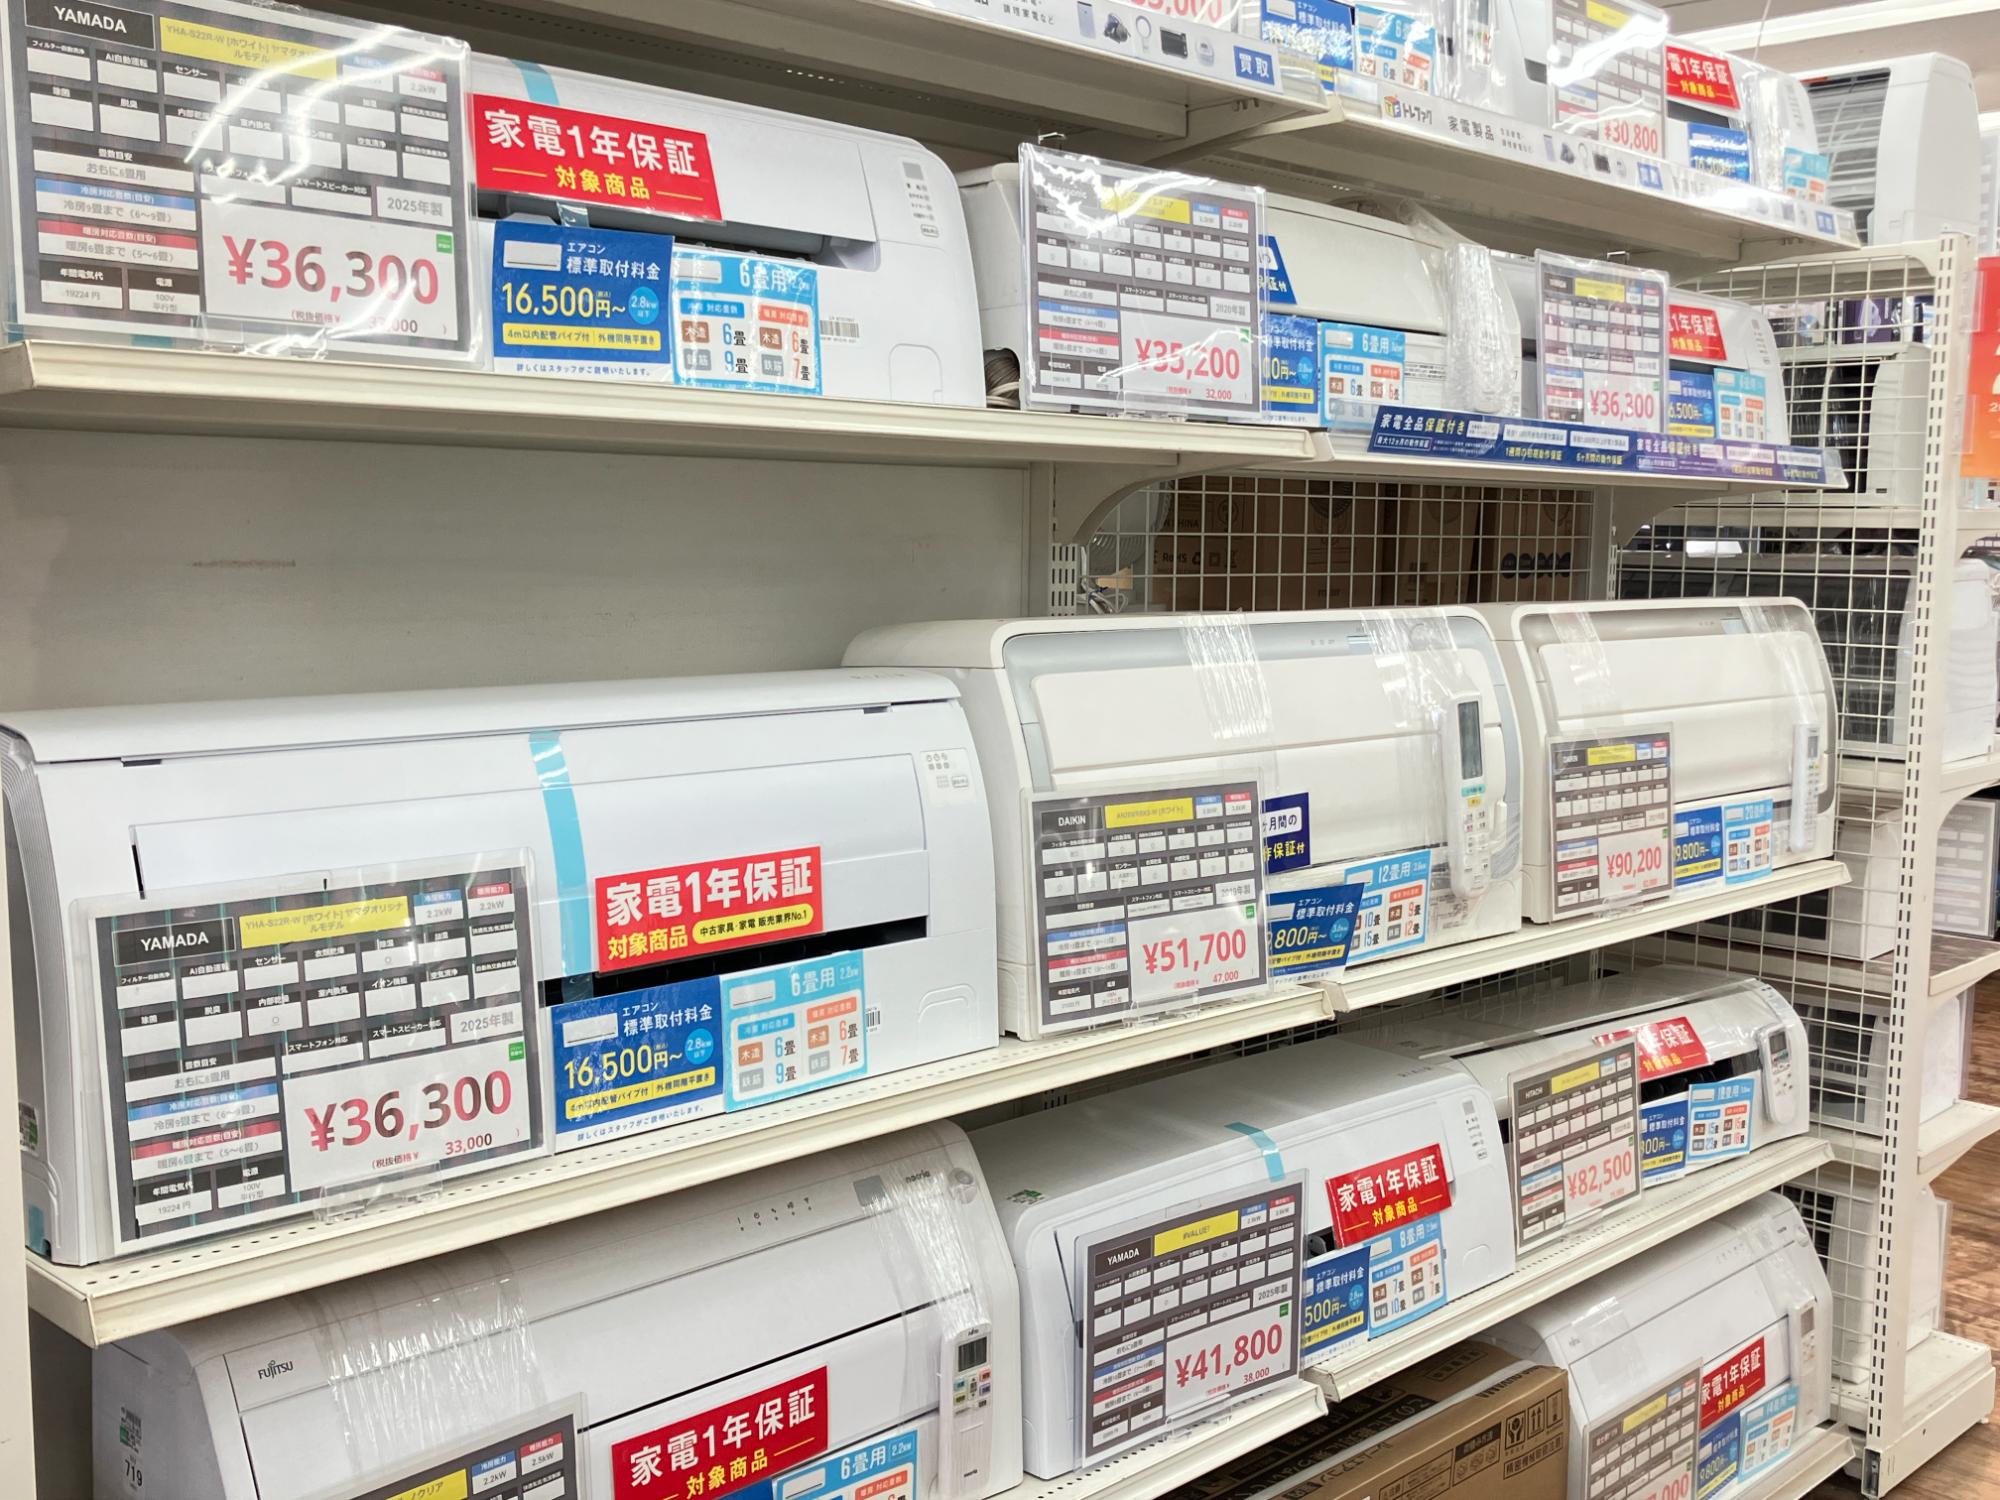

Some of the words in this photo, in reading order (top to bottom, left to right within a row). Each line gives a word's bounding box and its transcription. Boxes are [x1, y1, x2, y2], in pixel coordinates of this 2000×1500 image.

[54, 5, 127, 34] YAMADA
[1238, 51, 1275, 80] 買取
[1666, 53, 1729, 84] 電1年保証
[1448, 116, 1495, 142] 家電製品
[1604, 120, 1658, 154] ¥30,800
[483, 108, 700, 179] 家電1年保証
[554, 165, 651, 200] 対象商品
[387, 198, 443, 216] 2025年製
[567, 242, 606, 255] エアコン
[222, 234, 439, 305] ¥36,300
[566, 256, 661, 282] 標準取付料金
[739, 262, 789, 291] 6畳用
[91, 292, 100, 301] 円
[722, 322, 745, 347] 6畳
[791, 330, 809, 355] 6畳
[1362, 333, 1390, 354] 6畳用
[723, 351, 749, 374] 9畳
[1136, 337, 1240, 380] ¥35,200
[1206, 390, 1232, 400] 32,000
[1590, 389, 1654, 421] ¥36,300
[1380, 413, 1465, 436] 家電全品保証付き
[1058, 815, 1086, 826] DAIKIN
[1378, 862, 1410, 883] 12畳用
[1606, 847, 1661, 878] ¥90,200
[605, 855, 813, 927] 家電1年保証
[426, 906, 452, 919] 2.2kW
[479, 901, 505, 911] 2.2kW
[1296, 903, 1355, 921] 標準取付料金
[310, 921, 345, 933] ルモデル
[758, 909, 808, 928] 販売業界No.1
[141, 932, 209, 952] YAMADA
[607, 924, 688, 961] 対象商品
[1143, 928, 1246, 975] ¥51,700
[255, 955, 286, 966] センサー
[791, 966, 835, 996] 6畳用
[1213, 970, 1239, 983] 47,000
[622, 1002, 659, 1016] エアコン
[623, 1004, 713, 1037] 標準取付料金
[372, 1019, 442, 1039] スマートスピーカー対応
[460, 1011, 515, 1033] 2025年製
[810, 1031, 827, 1043] 木造
[839, 1020, 858, 1040] 6畳
[288, 1035, 349, 1053] スマートフォン対応
[742, 1047, 761, 1061] 木造
[775, 1036, 796, 1058] 6畳
[840, 1044, 859, 1065] 7畳
[775, 1063, 796, 1084] 9畳
[304, 1070, 512, 1152] ¥36,300
[445, 1132, 492, 1155] 33,000
[1337, 1154, 1440, 1214] 家電1年保証
[1567, 1150, 1632, 1200] ¥82,500
[182, 1201, 191, 1210] 円
[1372, 1196, 1418, 1228] 対象商品
[1399, 1224, 1425, 1248] 8畳用
[1107, 1247, 1140, 1266] YAMADA
[1316, 1268, 1336, 1280] エアコン
[1316, 1266, 1365, 1293] 標準取付料金
[1258, 1283, 1288, 1300] 2025年製
[1175, 1323, 1282, 1389] ¥41,800
[258, 1360, 294, 1379] FUJITSU
[1243, 1367, 1270, 1383] 38,000
[629, 1383, 815, 1487] 家電1年保証
[532, 1452, 554, 1466] 2.5kW
[841, 1446, 886, 1480] 6畳用
[125, 1459, 143, 1487] 719
[483, 1472, 507, 1485] 2.2kW
[685, 1447, 769, 1500] 対象商品
